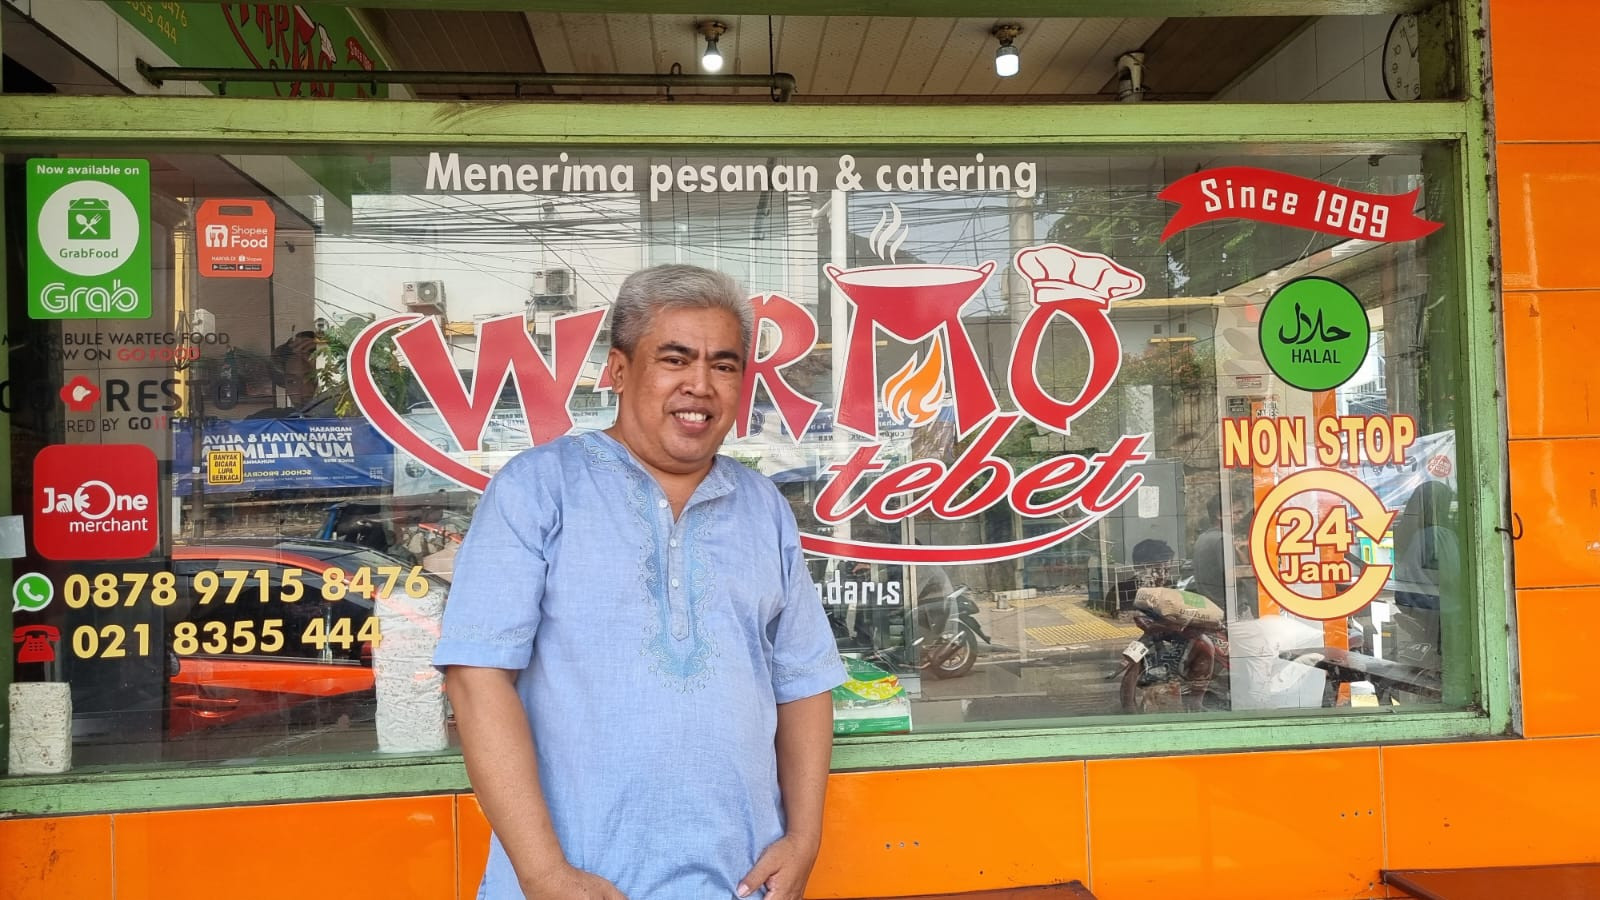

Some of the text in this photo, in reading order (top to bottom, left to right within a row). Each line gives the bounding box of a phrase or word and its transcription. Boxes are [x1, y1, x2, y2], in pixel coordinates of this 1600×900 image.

[37, 164, 140, 175] Now available on
[425, 152, 1037, 201] Menerima pesanan & catering
[1200, 178, 1389, 238] Since 1969
[231, 225, 268, 236] Shopee
[231, 235, 268, 248] Food
[59, 247, 119, 259] GrabFood
[41, 279, 139, 313] Grab
[64, 332, 103, 345] BULE
[109, 332, 176, 345] WARTEG
[181, 332, 230, 345] FOOD
[1278, 302, 1351, 345] حلال
[84, 348, 111, 361] ON
[391, 258, 1123, 452] WRMO
[1291, 348, 1341, 364] HALAL
[102, 417, 119, 433] BY
[1222, 415, 1307, 468] NON
[1316, 414, 1416, 468] STOP
[813, 412, 1152, 523] tebet
[69, 517, 149, 533] merchant
[1277, 505, 1353, 555] 24
[1279, 554, 1352, 584] Jam
[64, 565, 430, 609] 0878 9715 8476
[72, 616, 383, 659] 021 8355 444
